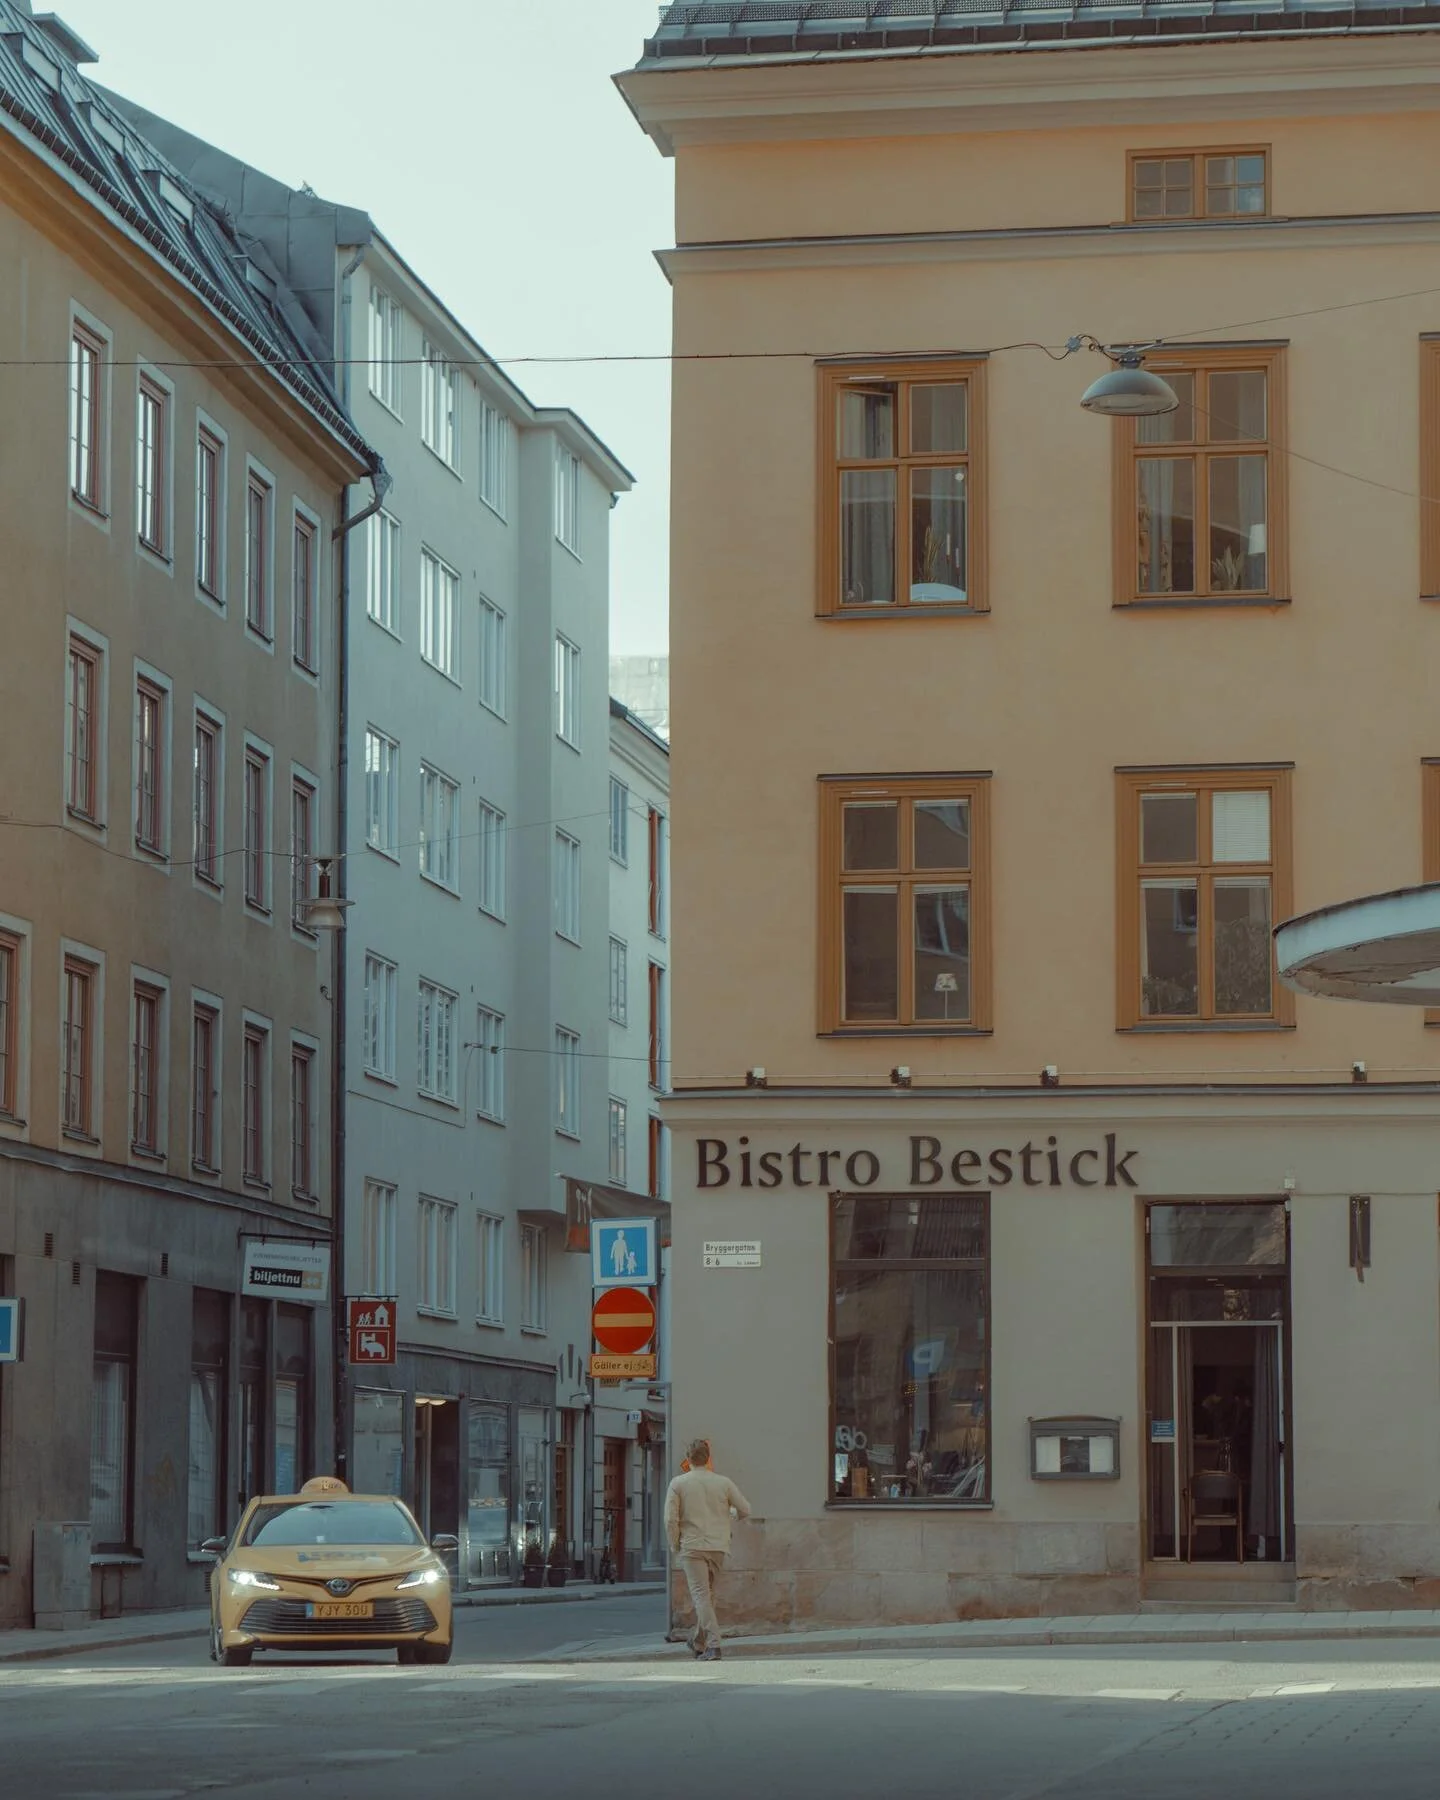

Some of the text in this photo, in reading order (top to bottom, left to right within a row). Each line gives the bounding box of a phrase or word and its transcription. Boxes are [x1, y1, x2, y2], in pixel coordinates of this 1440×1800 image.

[697, 1133, 1139, 1188] Bistro Bestick
[318, 1605, 340, 1616] YJY
